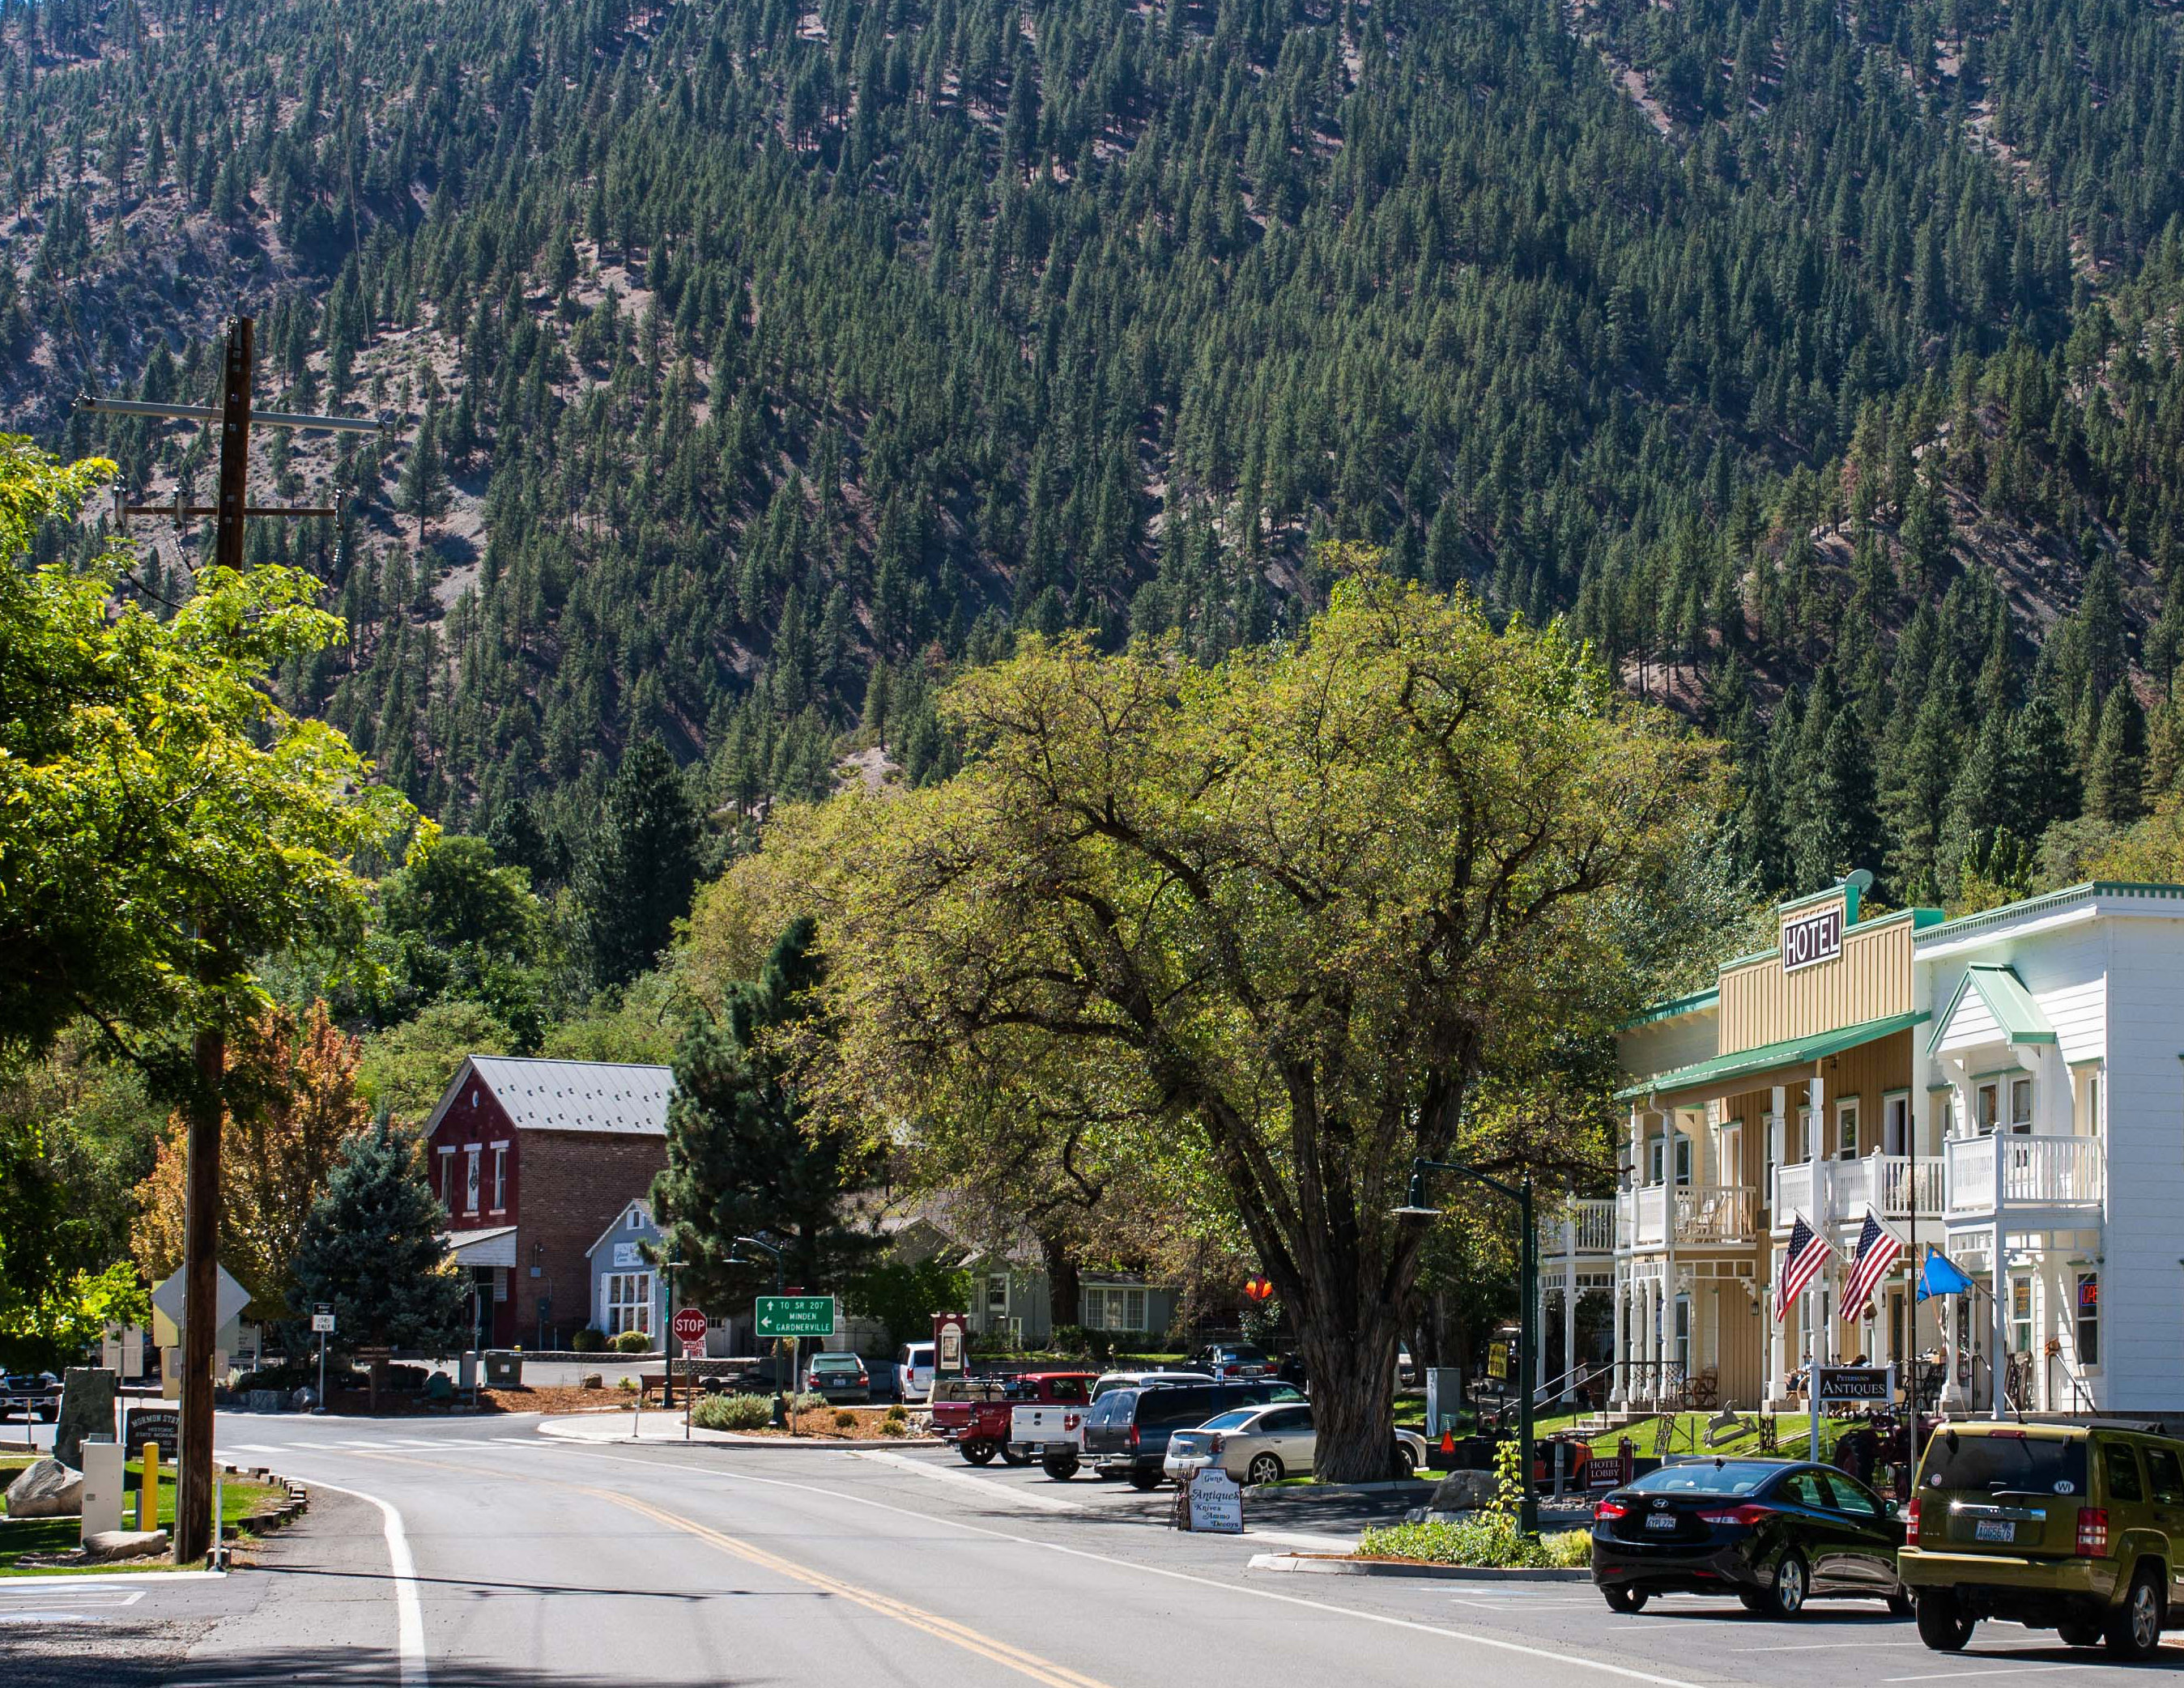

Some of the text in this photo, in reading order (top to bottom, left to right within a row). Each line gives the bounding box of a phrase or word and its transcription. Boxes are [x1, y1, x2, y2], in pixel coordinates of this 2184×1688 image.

[1786, 915, 1839, 966] HOTEL
[2083, 1284, 2098, 1303] OPE
[781, 1301, 824, 1310] TO SR 207
[789, 1312, 817, 1320] MINDEN
[675, 1319, 705, 1332] STOP
[776, 1323, 830, 1332] GARDNERVILLE
[1822, 1380, 1885, 1396] ANTIQUES
[131, 1414, 179, 1428] MORMON STAT
[1590, 1459, 1620, 1469] HOTEL
[1591, 1469, 1619, 1478] LOBBY
[2058, 1483, 2071, 1492] WI
[1194, 1503, 1221, 1512] Knives
[1203, 1512, 1230, 1520] Ammo
[1211, 1520, 1239, 1529] Decoys
